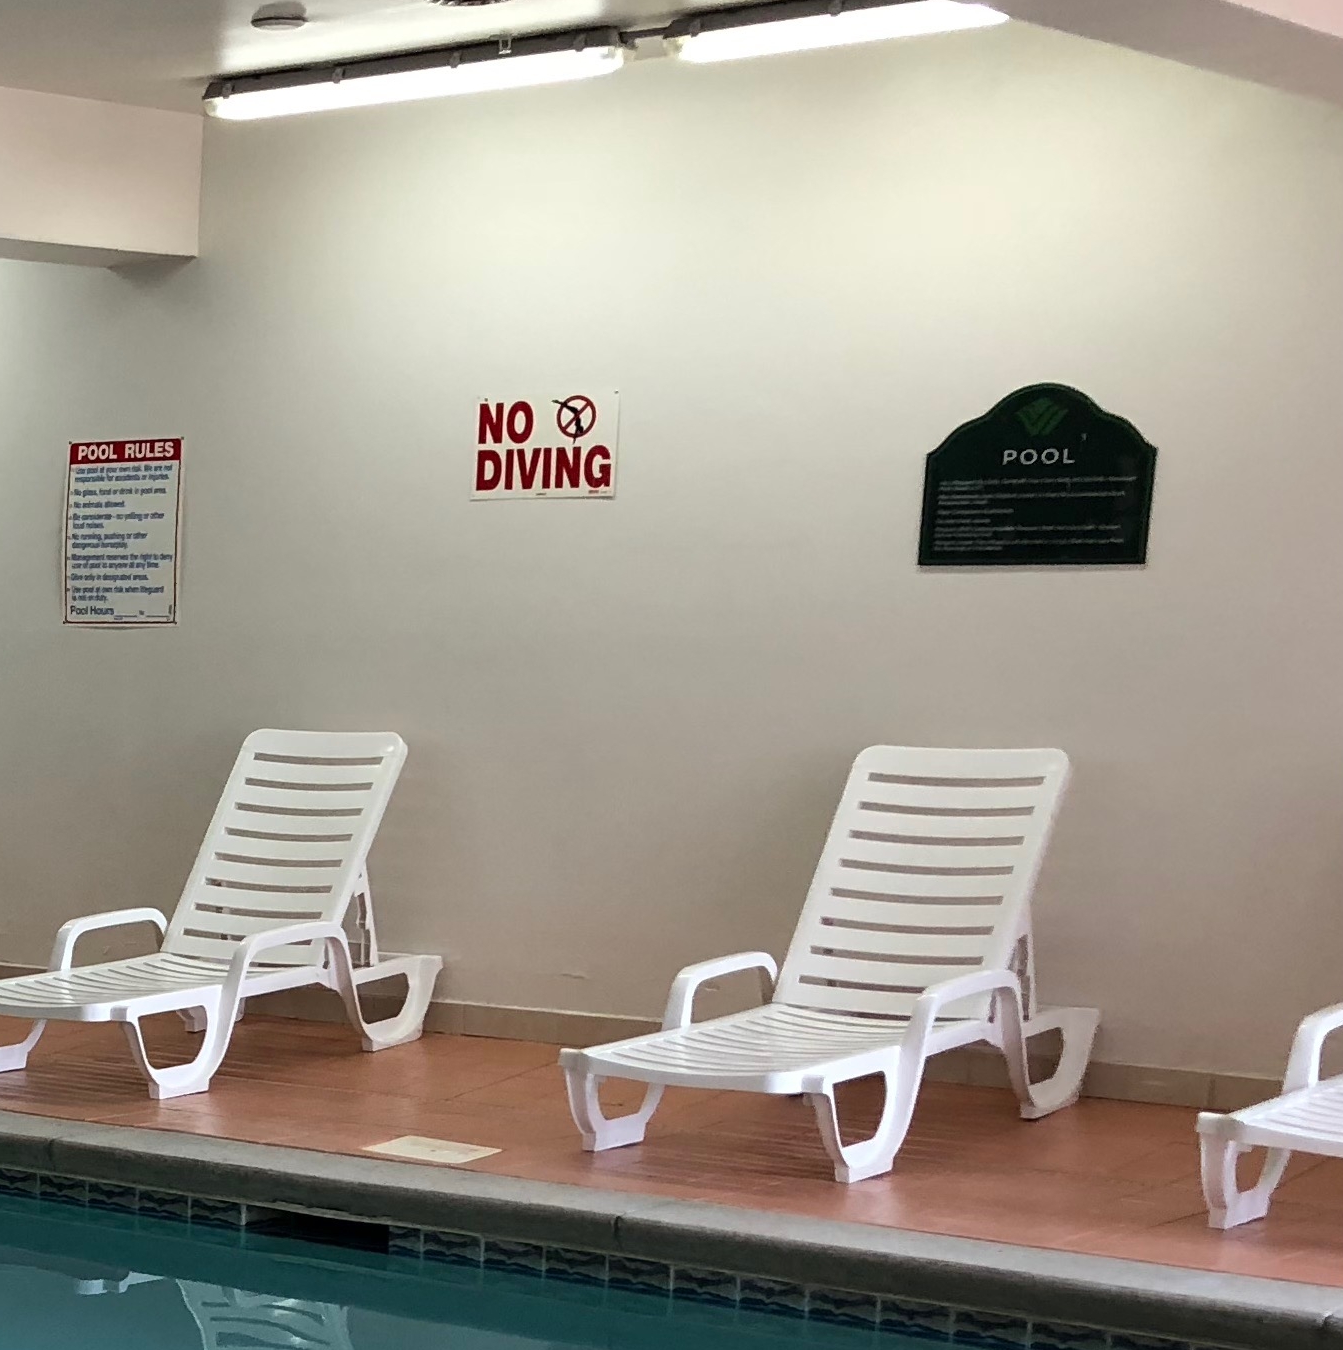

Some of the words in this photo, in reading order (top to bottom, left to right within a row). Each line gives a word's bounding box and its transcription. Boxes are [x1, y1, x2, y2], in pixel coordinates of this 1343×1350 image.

[478, 401, 534, 445] NO
[78, 444, 118, 460] POOL
[124, 441, 174, 459] RULES
[1002, 448, 1075, 465] POOL
[476, 445, 612, 491] DIVING
[70, 605, 88, 615] Pool
[90, 606, 114, 615] Hours
